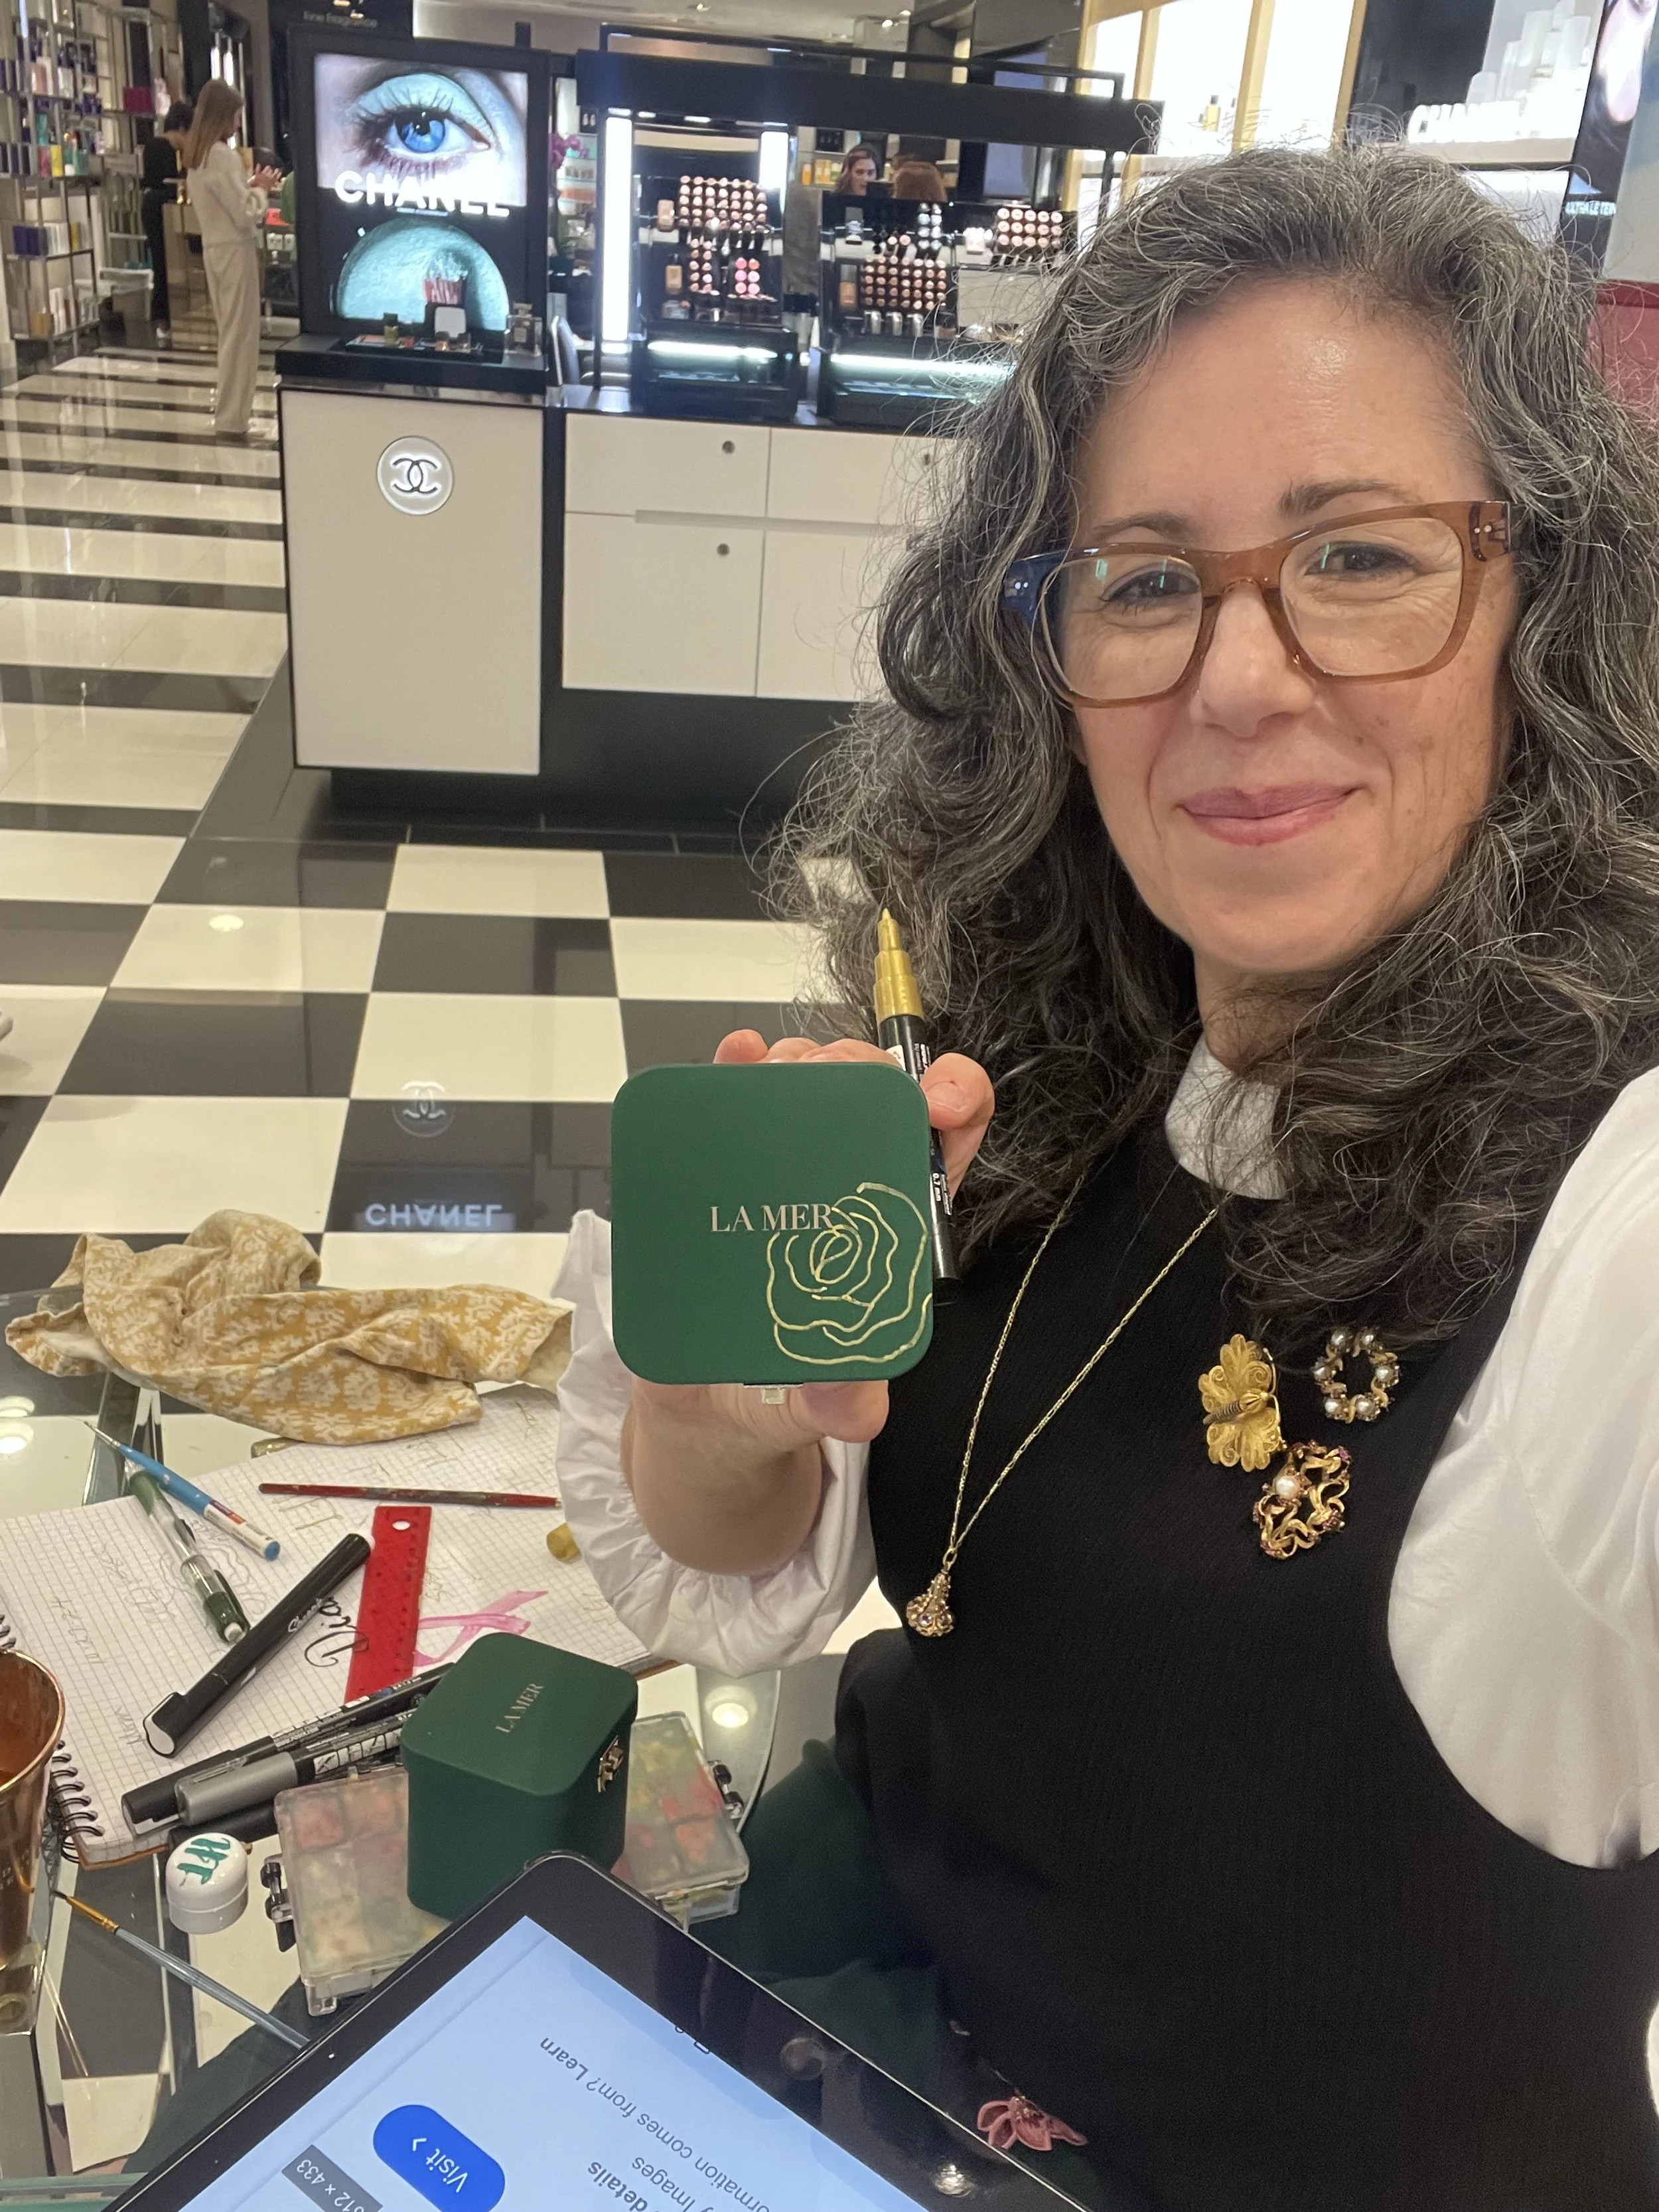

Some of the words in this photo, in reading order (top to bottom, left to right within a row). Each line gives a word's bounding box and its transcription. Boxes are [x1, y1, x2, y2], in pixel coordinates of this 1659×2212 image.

[932, 1173, 941, 1186] 0.7
[934, 1186, 942, 1202] mm
[710, 1205, 755, 1232] LA
[760, 1203, 835, 1231] MER
[496, 1716, 521, 1733] LA
[510, 1683, 544, 1714] MER
[540, 2037, 589, 2081] Learn
[587, 2078, 637, 2118] from?
[637, 2113, 693, 2158] comes
[297, 2159, 325, 2185] 433
[426, 2148, 468, 2193] Visit
[587, 2162, 648, 2212] details
[632, 2157, 695, 2212] Images
